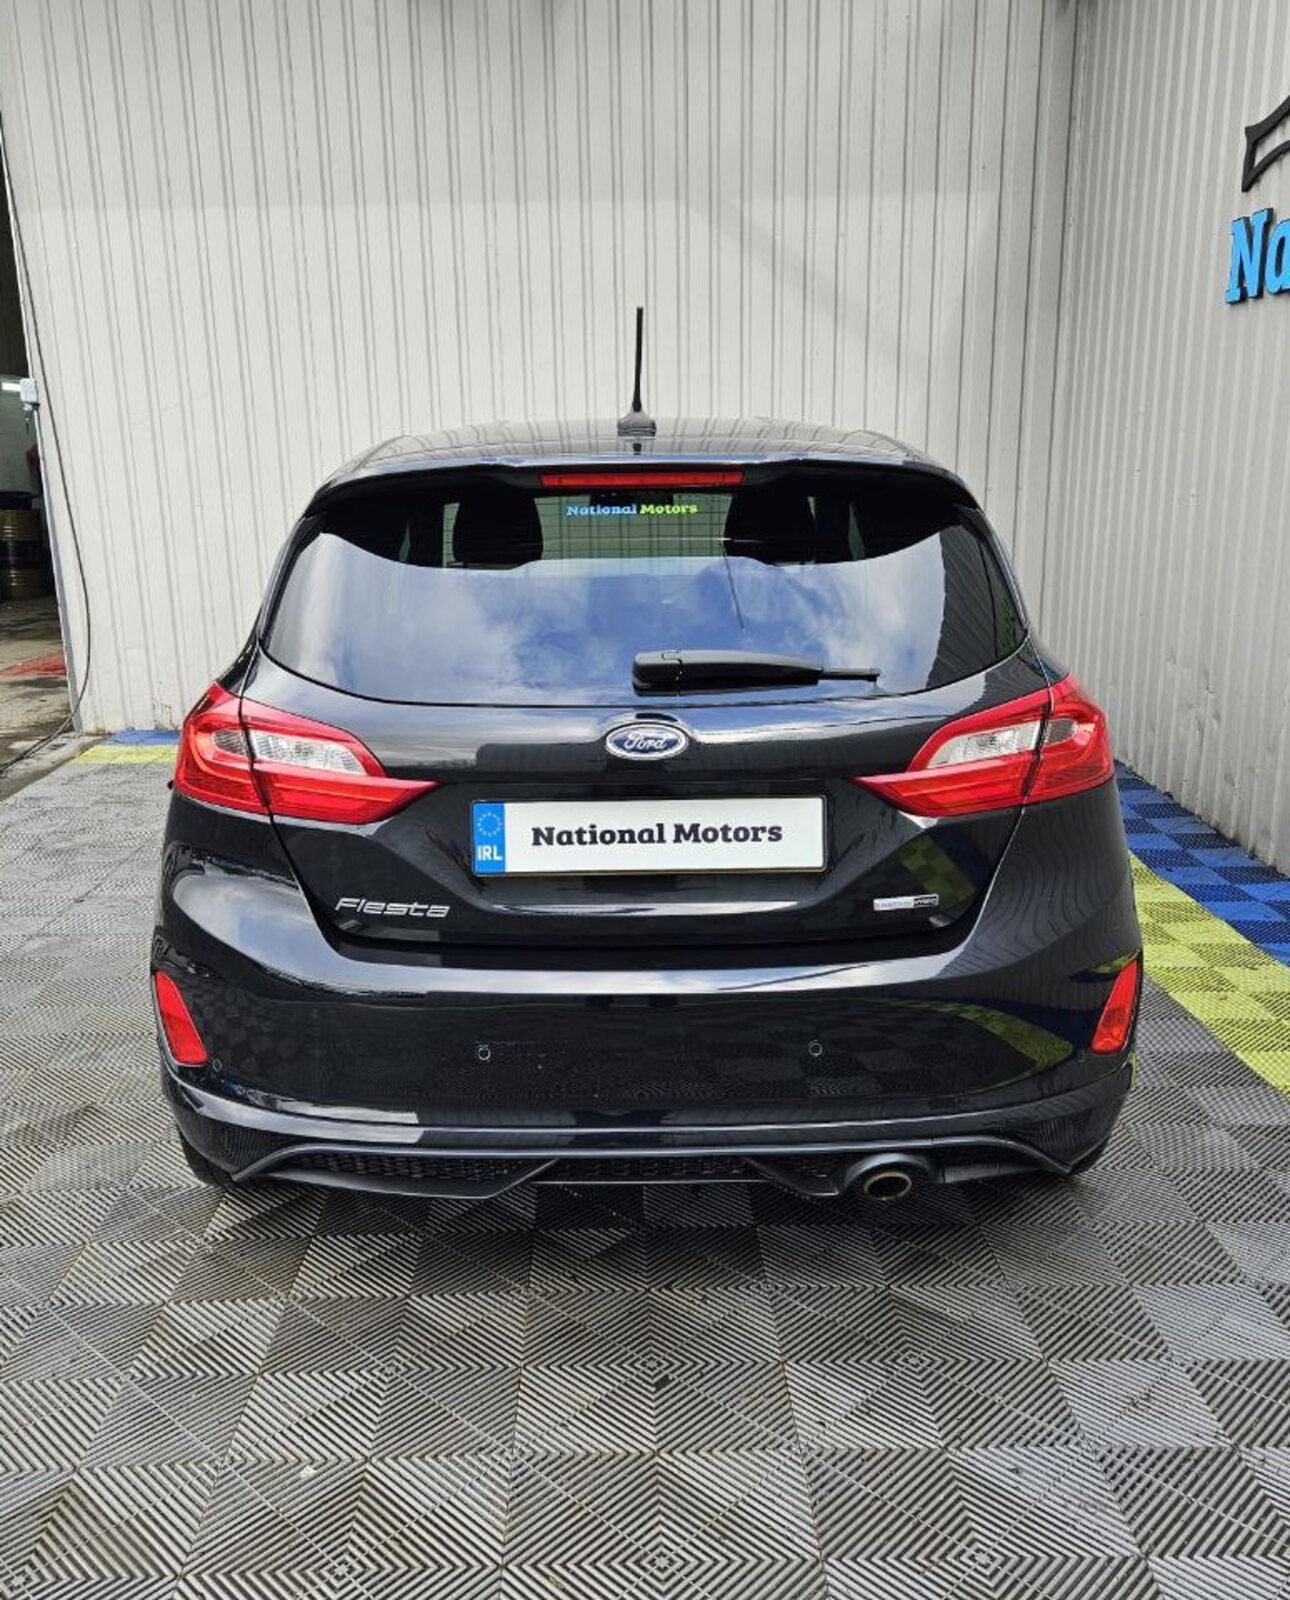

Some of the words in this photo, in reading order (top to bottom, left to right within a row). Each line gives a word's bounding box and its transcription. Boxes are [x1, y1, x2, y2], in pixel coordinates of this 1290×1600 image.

[566, 504, 637, 516] National
[640, 503, 698, 514] Motors
[624, 732, 669, 749] Ford
[531, 823, 667, 846] National
[674, 822, 783, 844] Motors
[477, 846, 503, 861] IRL
[334, 897, 450, 917] Fiesta
